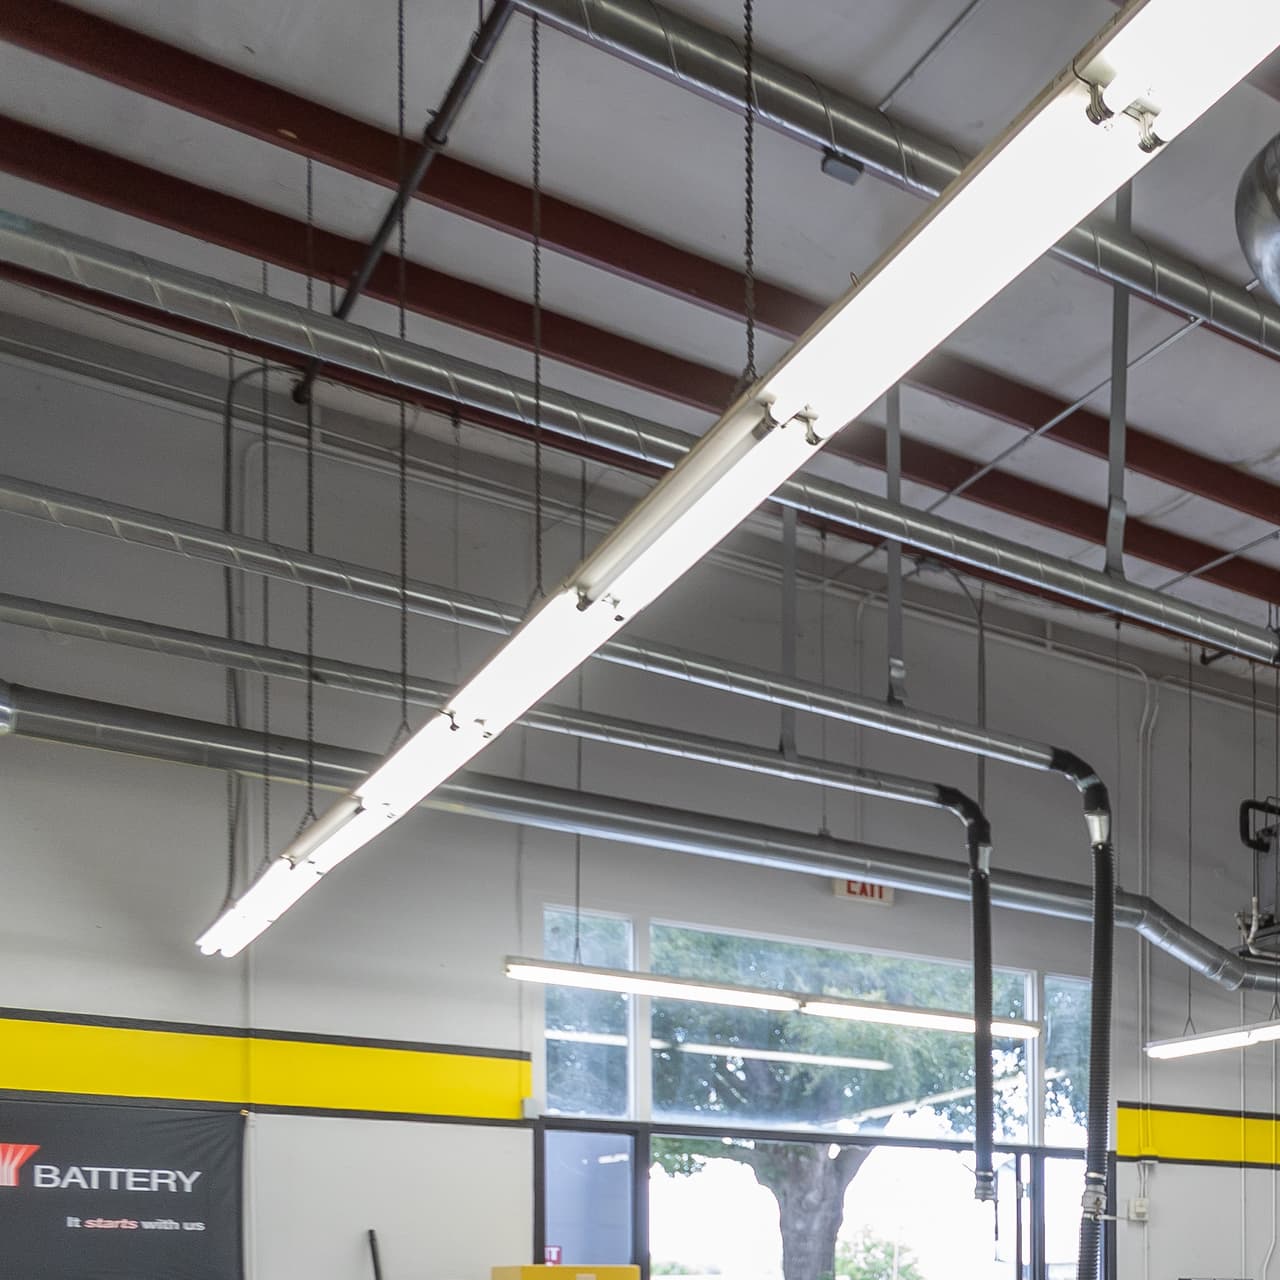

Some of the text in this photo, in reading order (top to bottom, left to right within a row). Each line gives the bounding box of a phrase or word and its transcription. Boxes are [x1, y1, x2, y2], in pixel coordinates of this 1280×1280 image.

[33, 1164, 202, 1193] BATTERY
[66, 1216, 206, 1231] It starts with us
